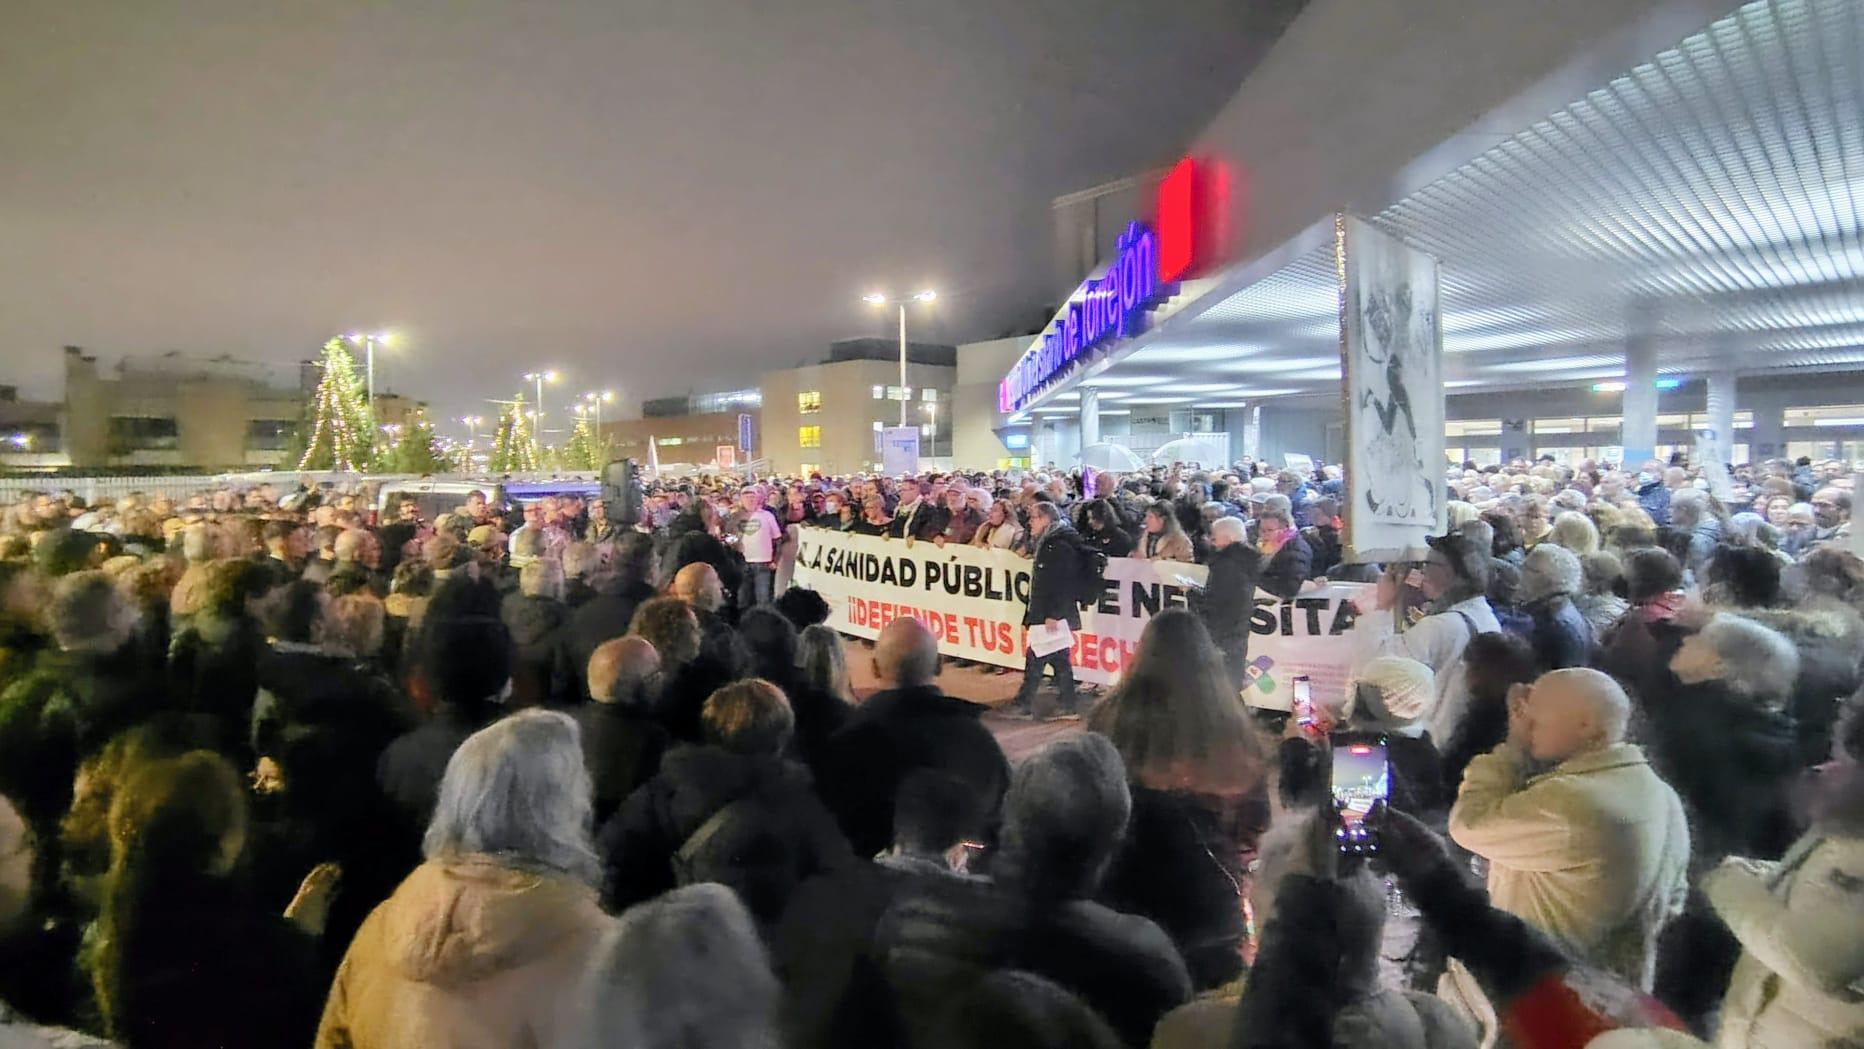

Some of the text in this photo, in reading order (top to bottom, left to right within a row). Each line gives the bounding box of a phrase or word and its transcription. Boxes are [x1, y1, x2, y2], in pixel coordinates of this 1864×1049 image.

[825, 547, 917, 587] SANIDAD
[925, 555, 1031, 604] PÚBLIC
[1081, 579, 1121, 615] E
[1131, 581, 1362, 637] NESITA
[963, 617, 1014, 656] TUS
